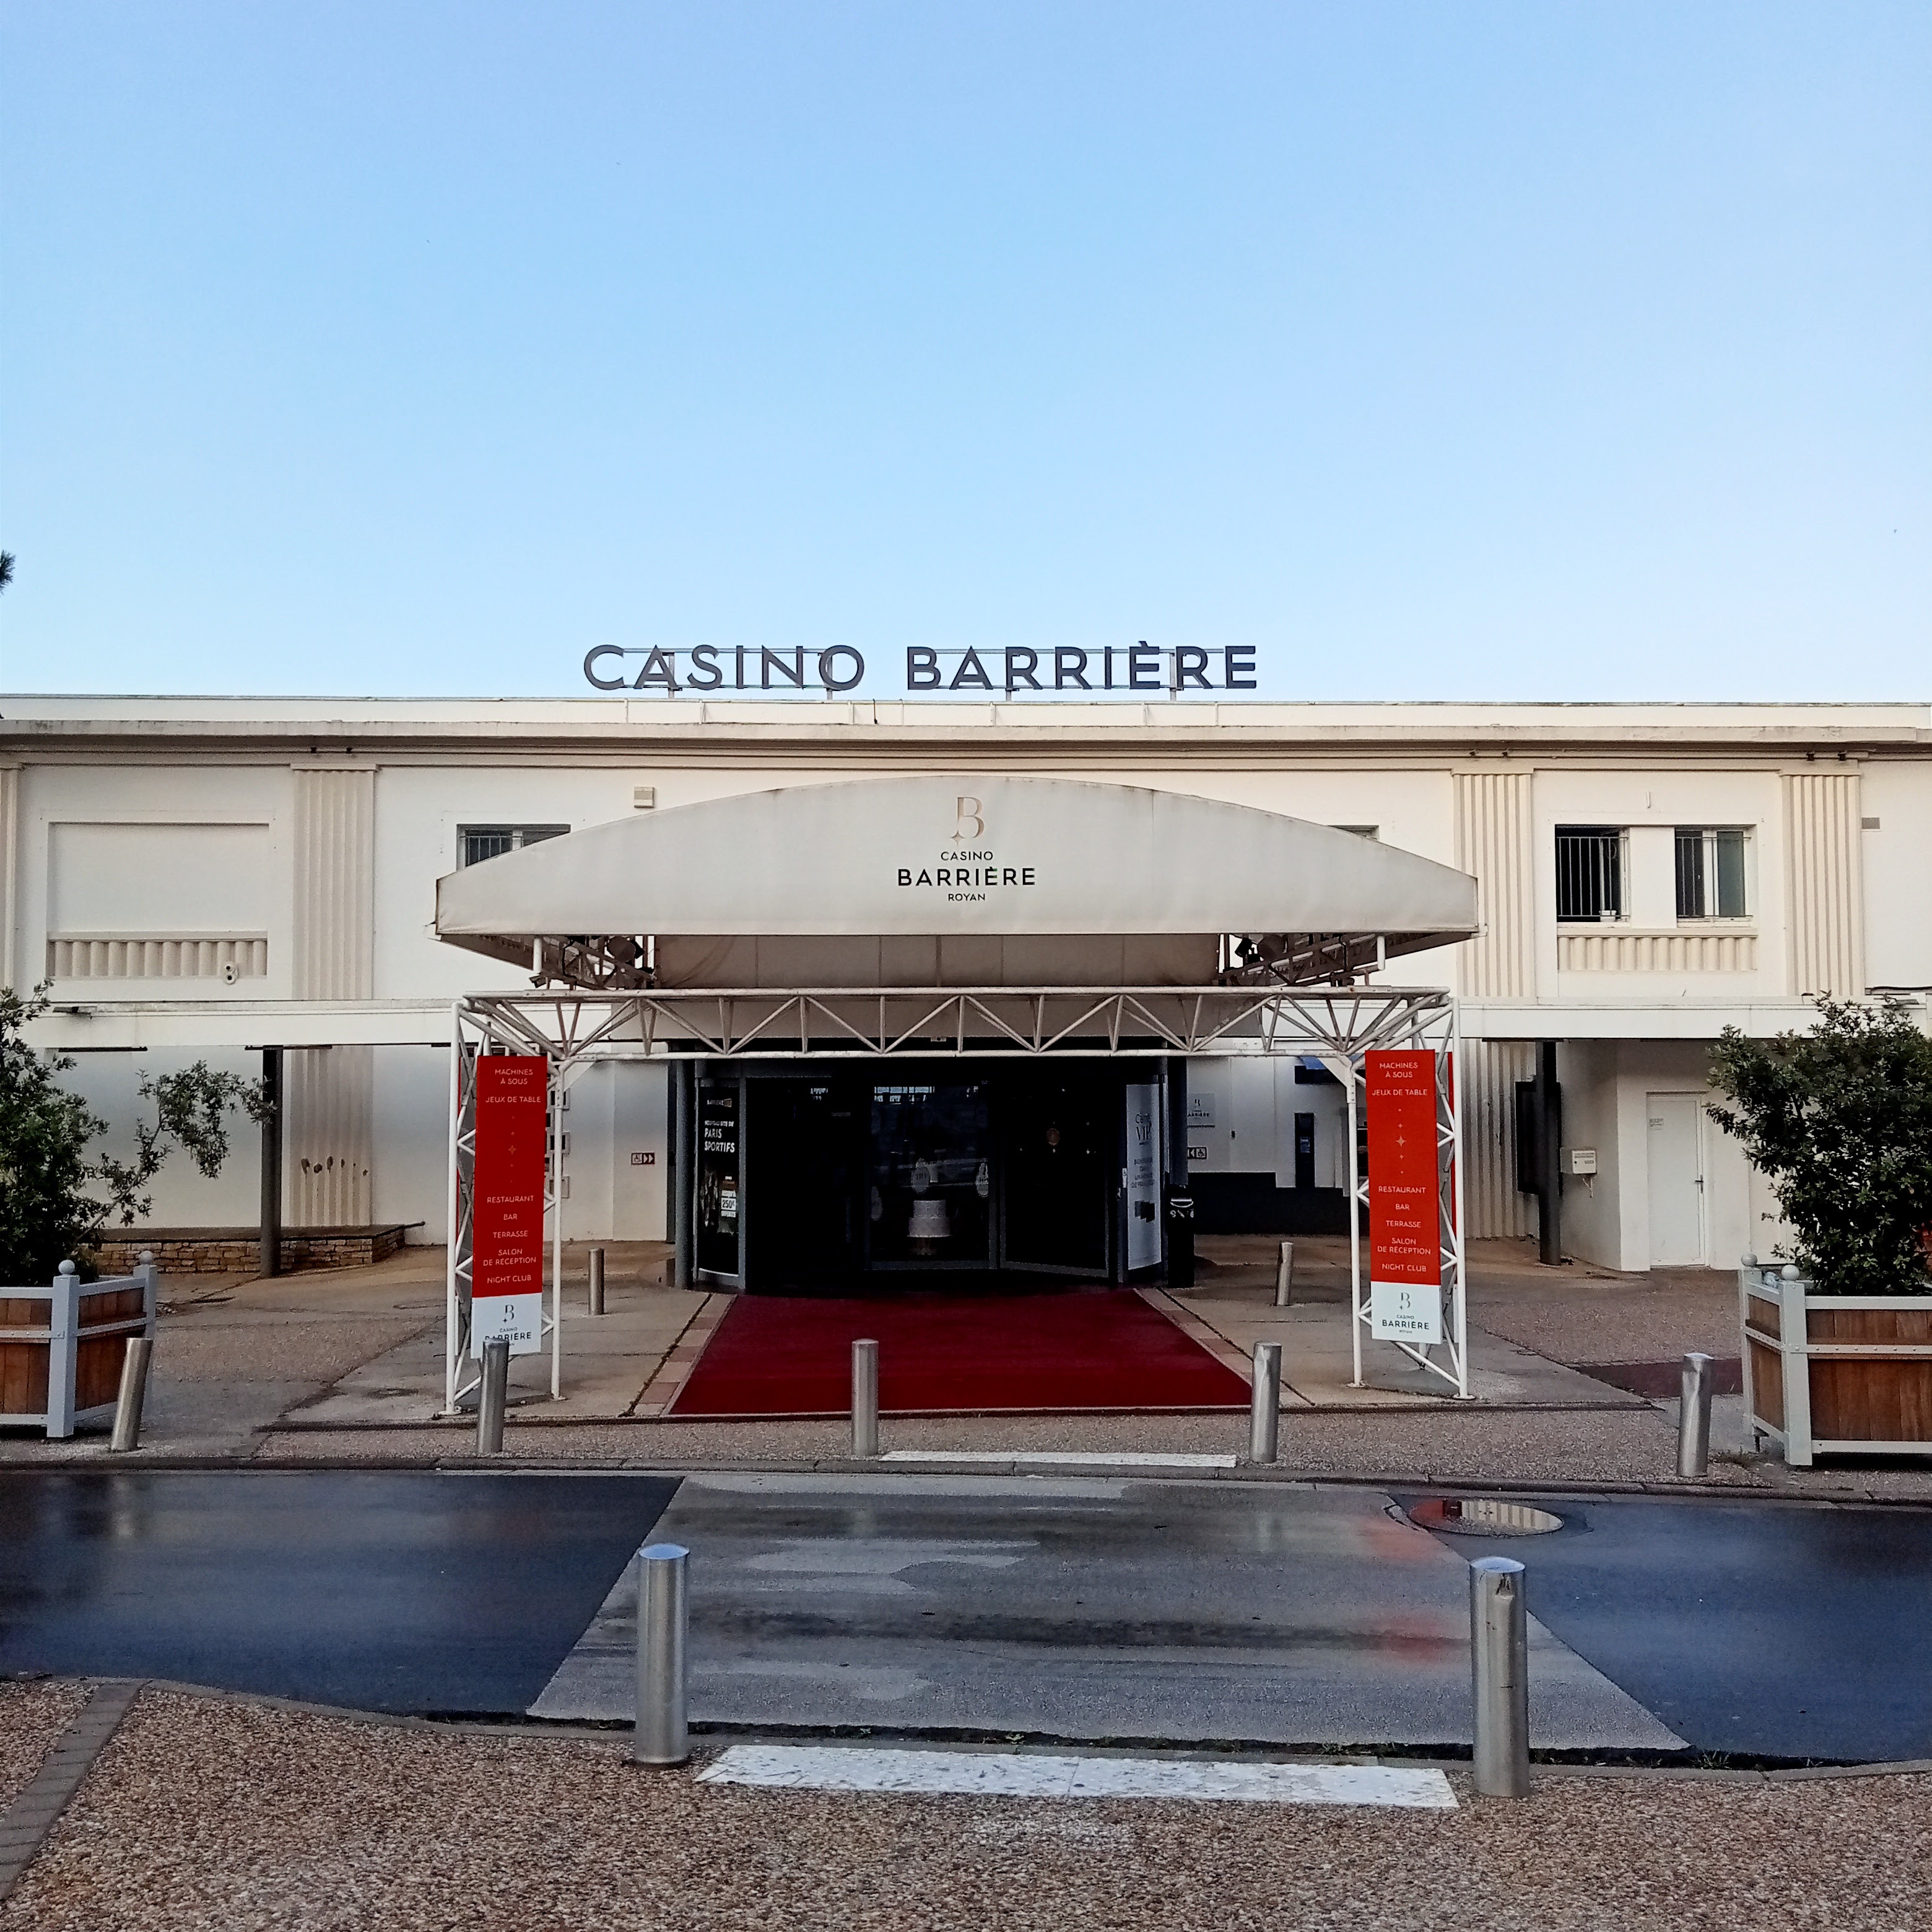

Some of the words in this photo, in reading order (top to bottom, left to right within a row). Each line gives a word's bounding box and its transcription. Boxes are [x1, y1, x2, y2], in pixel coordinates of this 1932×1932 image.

[583, 645, 865, 691] CASINO
[907, 640, 1257, 691] BARRIÈRE
[941, 851, 993, 861] CASINO
[898, 866, 1035, 886] BARRIÈRE
[948, 893, 986, 902] ROYAN
[1379, 1061, 1419, 1069] MACHINES
[704, 1128, 722, 1139] PARIS
[704, 1141, 735, 1153] SPORTIFS
[1378, 1186, 1427, 1194] RESTAURANT
[487, 1194, 534, 1203] RESTAURANT
[1386, 1220, 1422, 1228] TERRASSE
[493, 1230, 529, 1238] TERRASSE
[1391, 1237, 1417, 1245] SALON
[1382, 1263, 1404, 1271] NIGHT
[487, 1276, 510, 1284] NIGHT
